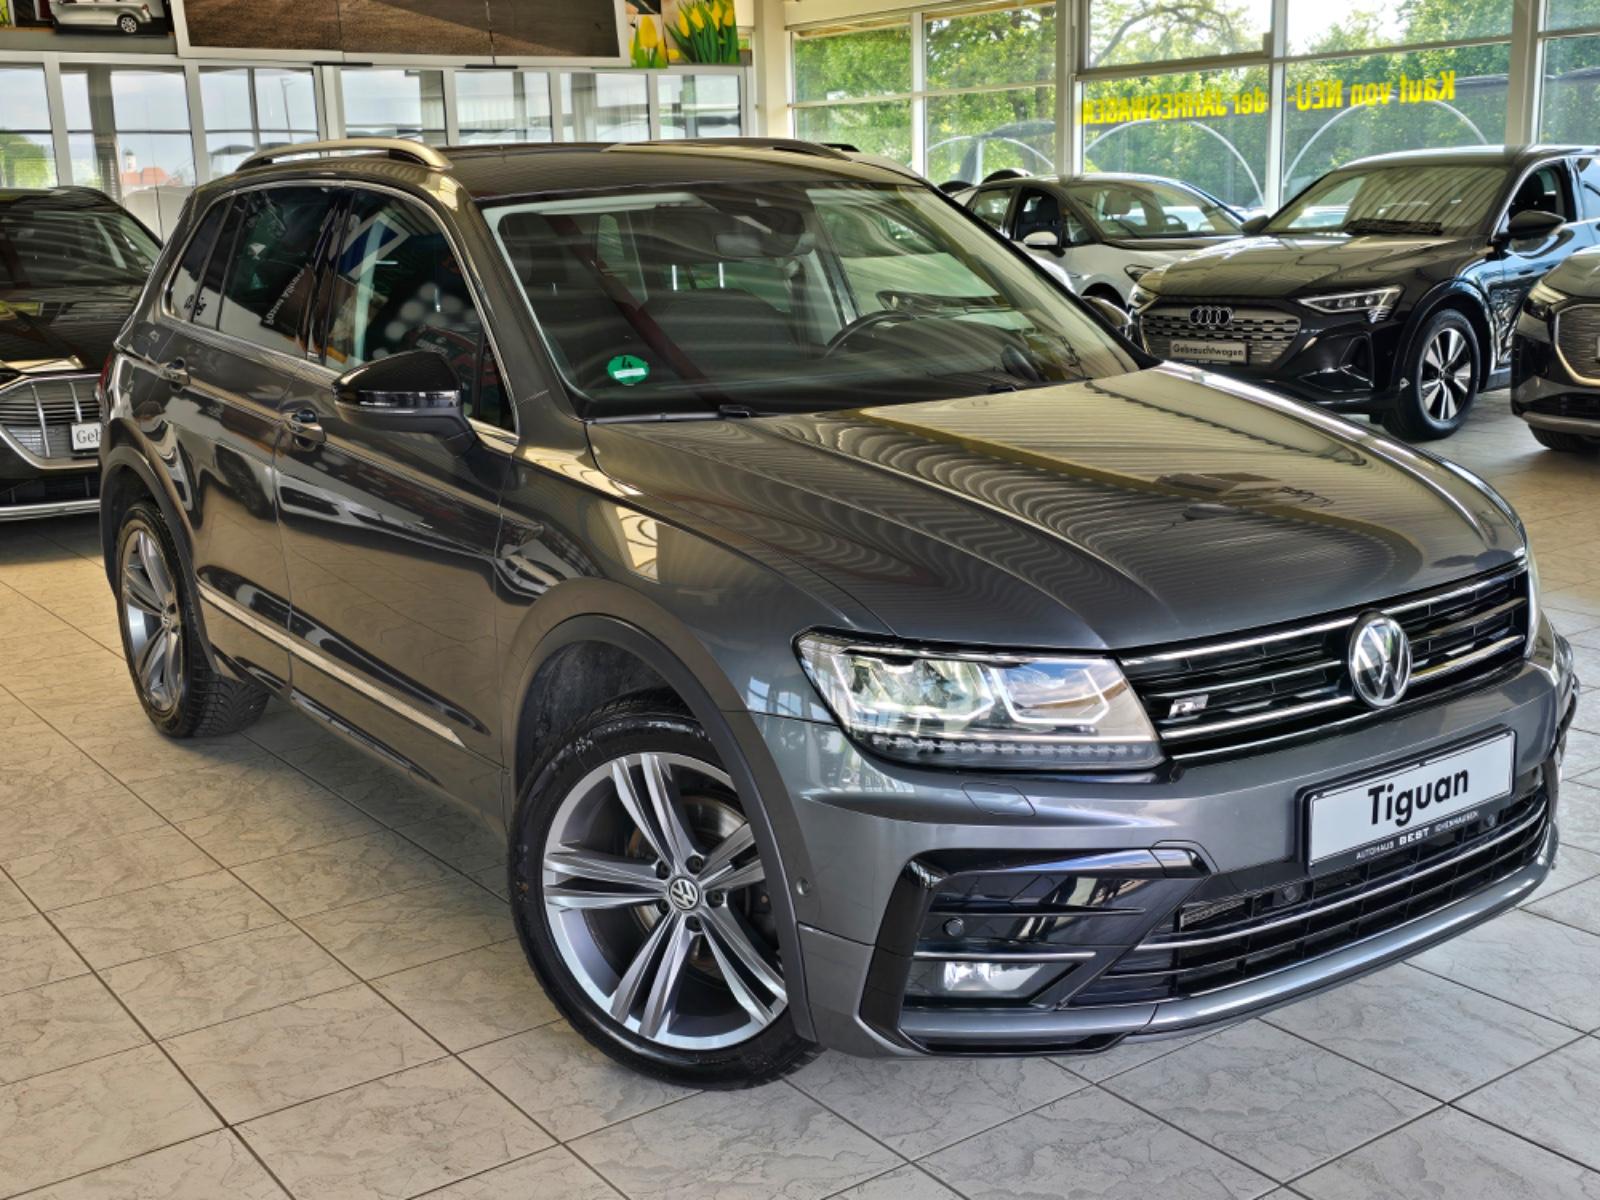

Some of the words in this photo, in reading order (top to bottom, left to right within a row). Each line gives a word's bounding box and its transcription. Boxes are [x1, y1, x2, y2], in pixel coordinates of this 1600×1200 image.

[1173, 344, 1243, 357] Gebrauchtwagen
[1368, 769, 1468, 826] Tiguan
[1399, 826, 1429, 845] BEST
